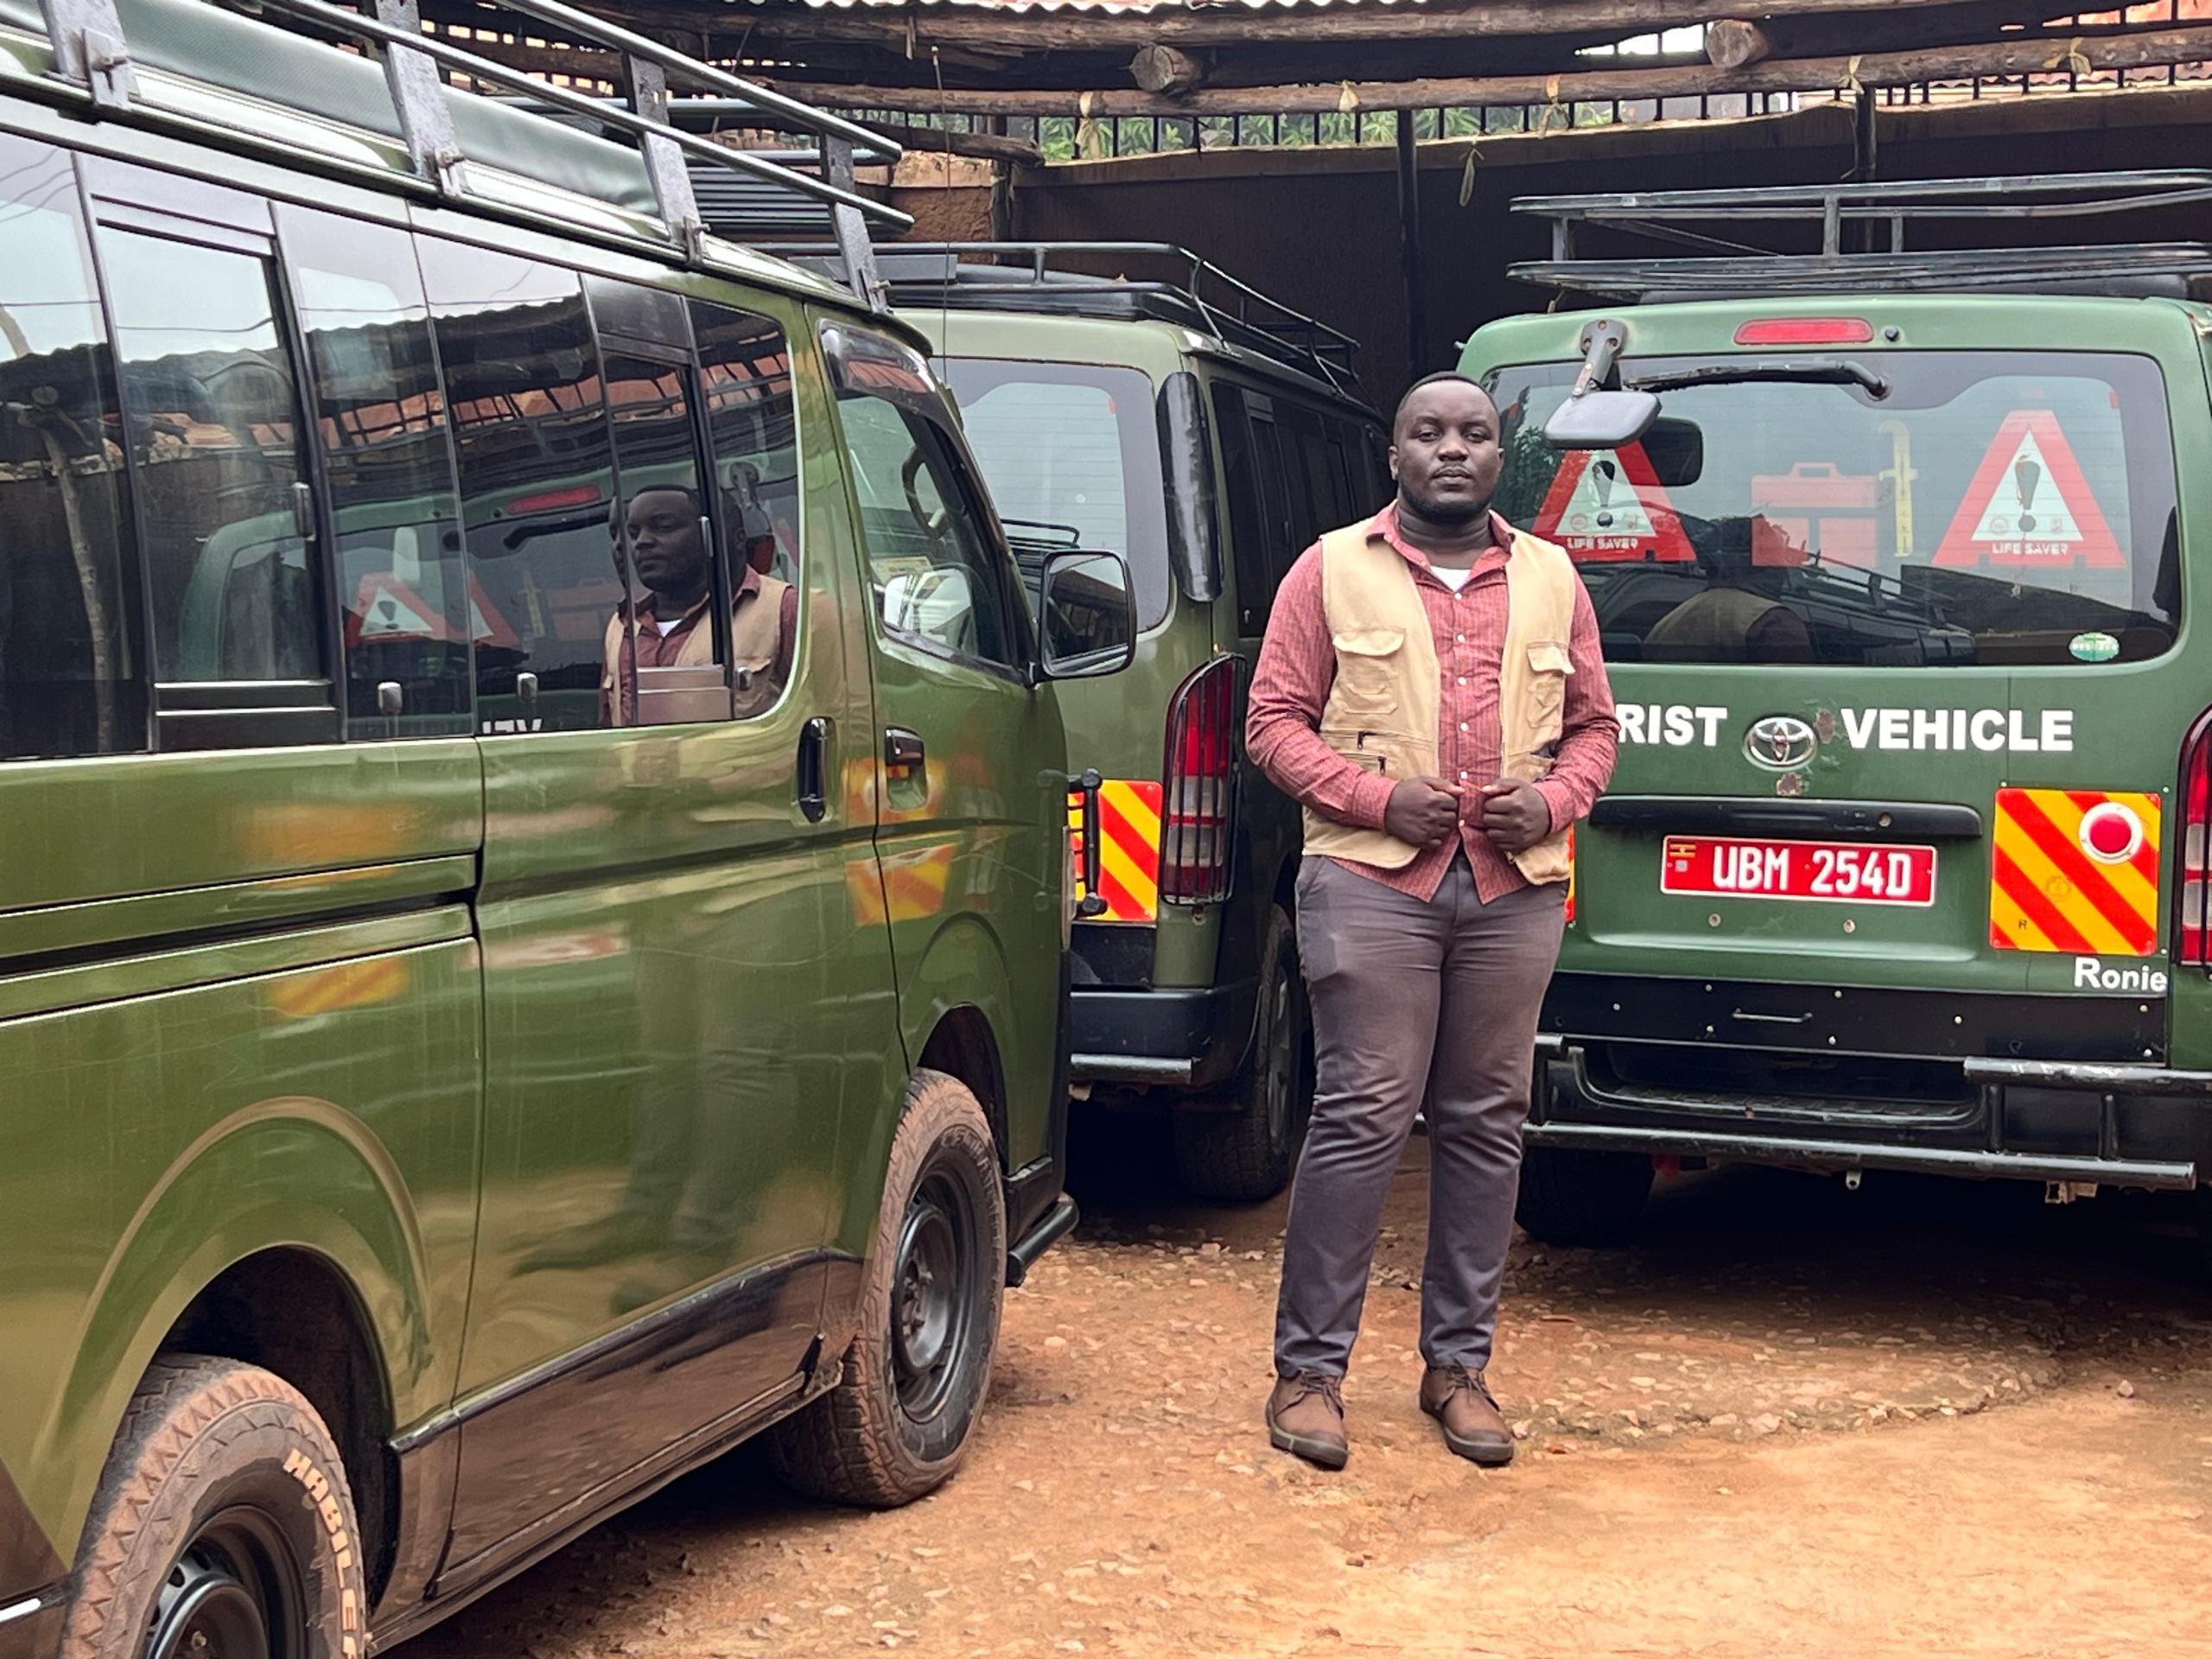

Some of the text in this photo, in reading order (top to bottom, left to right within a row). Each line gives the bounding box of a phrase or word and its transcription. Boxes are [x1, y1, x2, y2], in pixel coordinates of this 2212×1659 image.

[1567, 537, 1639, 550] LIFE SAVER
[1992, 542, 2069, 556] LIFE SAVER
[1840, 708, 2074, 751] VEHICLE
[1713, 845, 1912, 897] UBM 254D
[2074, 956, 2168, 992] Ronie
